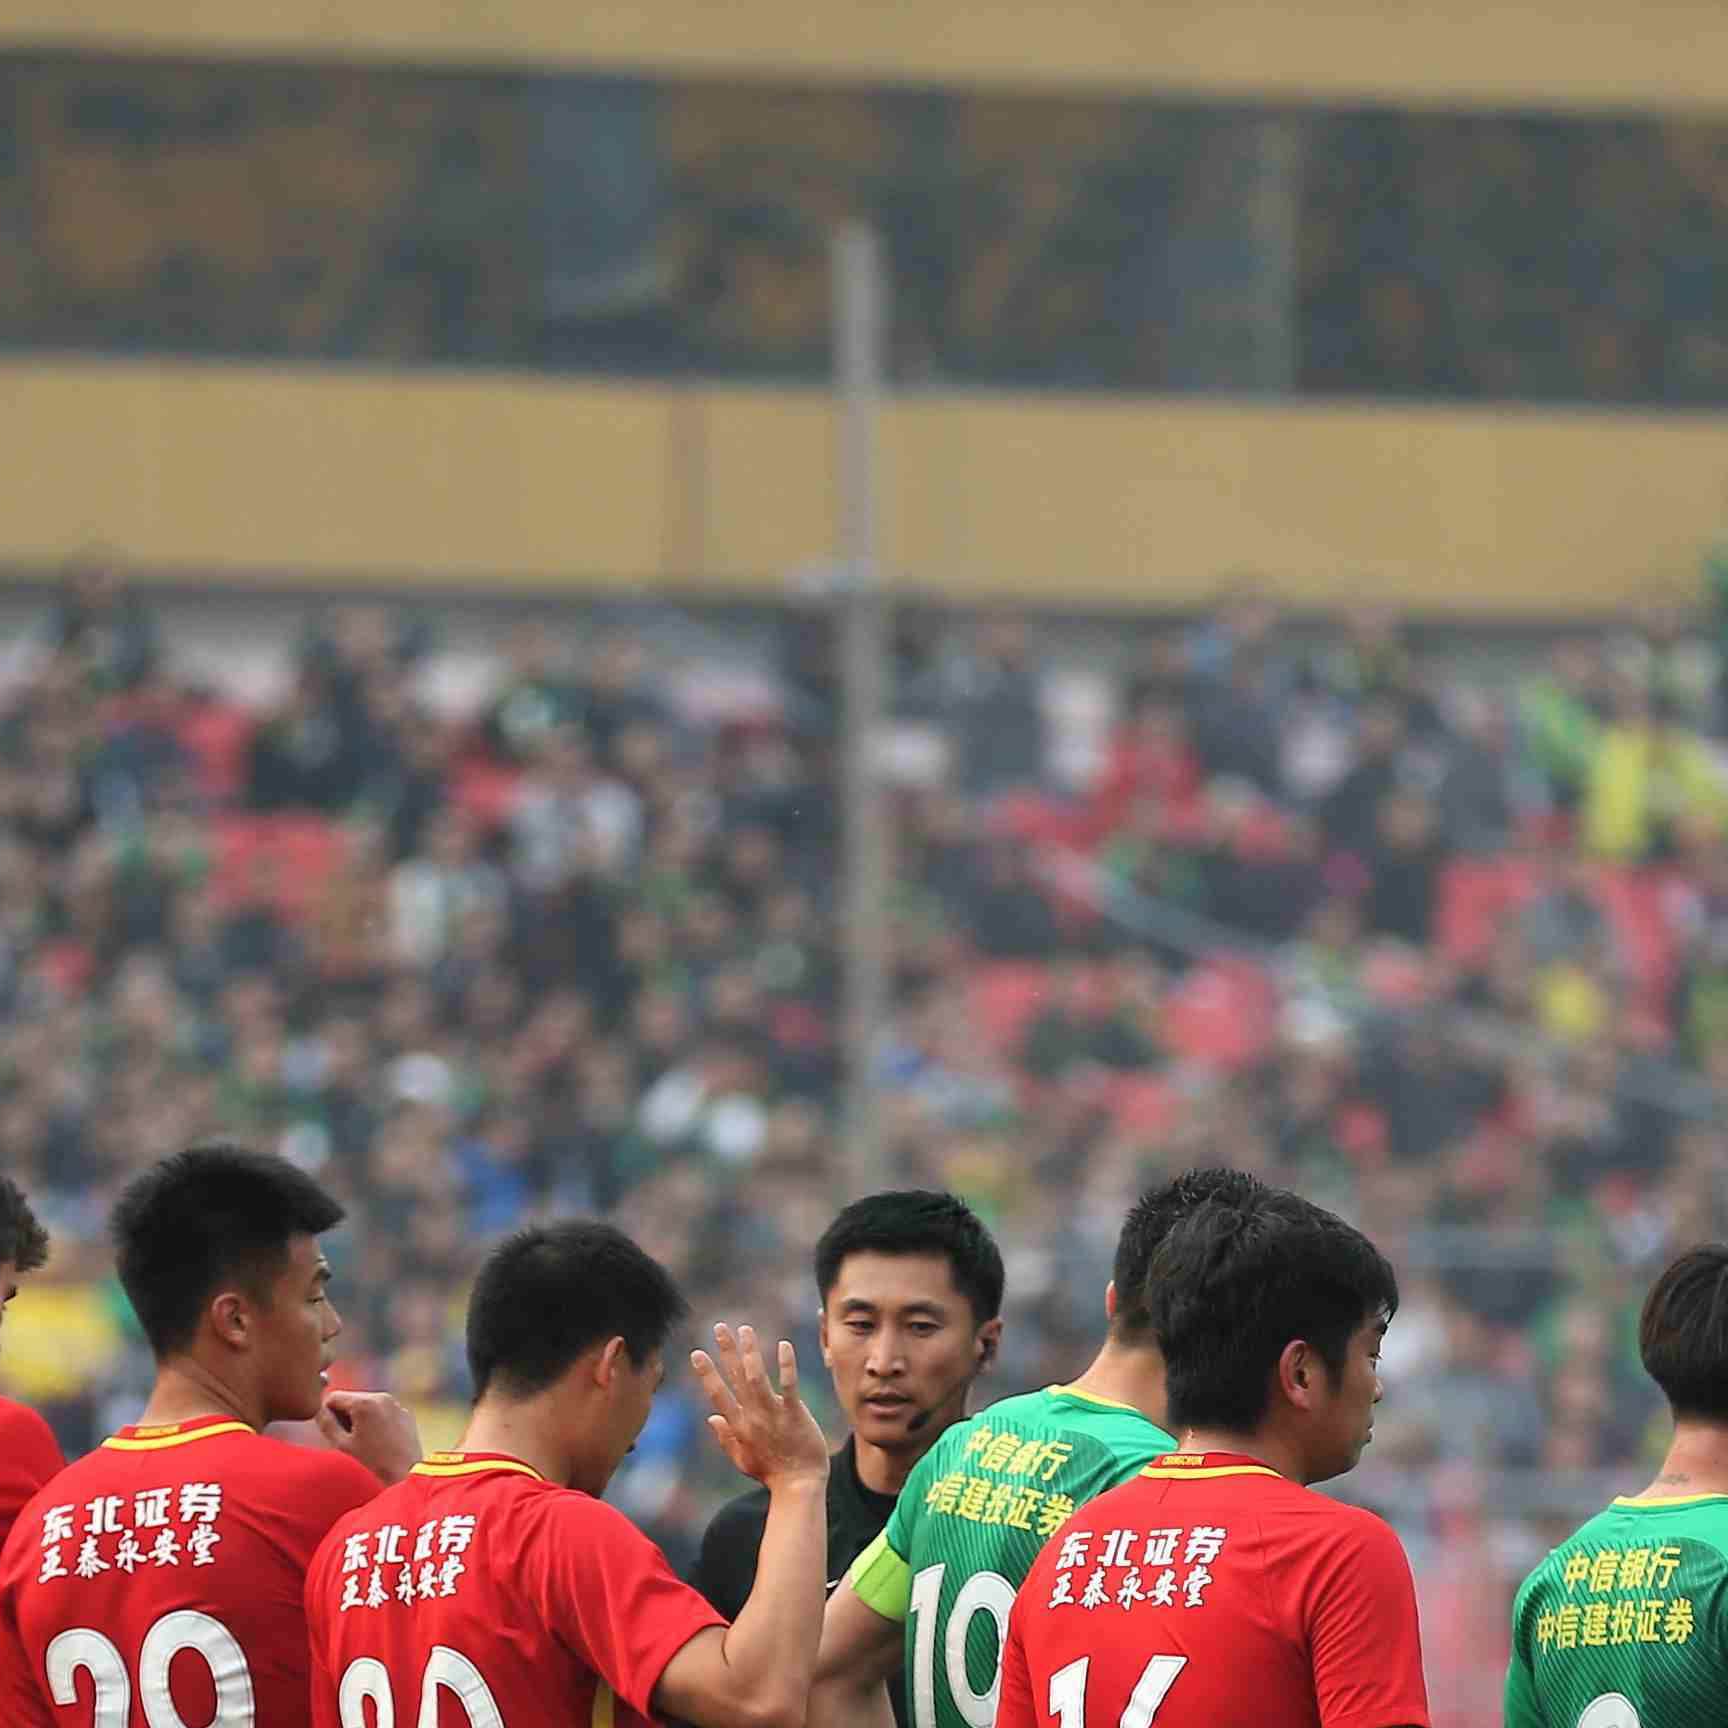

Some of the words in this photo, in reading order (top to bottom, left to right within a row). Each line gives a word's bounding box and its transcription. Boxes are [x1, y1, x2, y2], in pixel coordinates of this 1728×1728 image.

[40, 1482, 222, 1547] 东北证券
[1055, 1526, 1227, 1571] 东北证券
[1562, 1545, 1681, 1594] 中信银行
[1535, 1597, 1695, 1654] 中信建投证券
